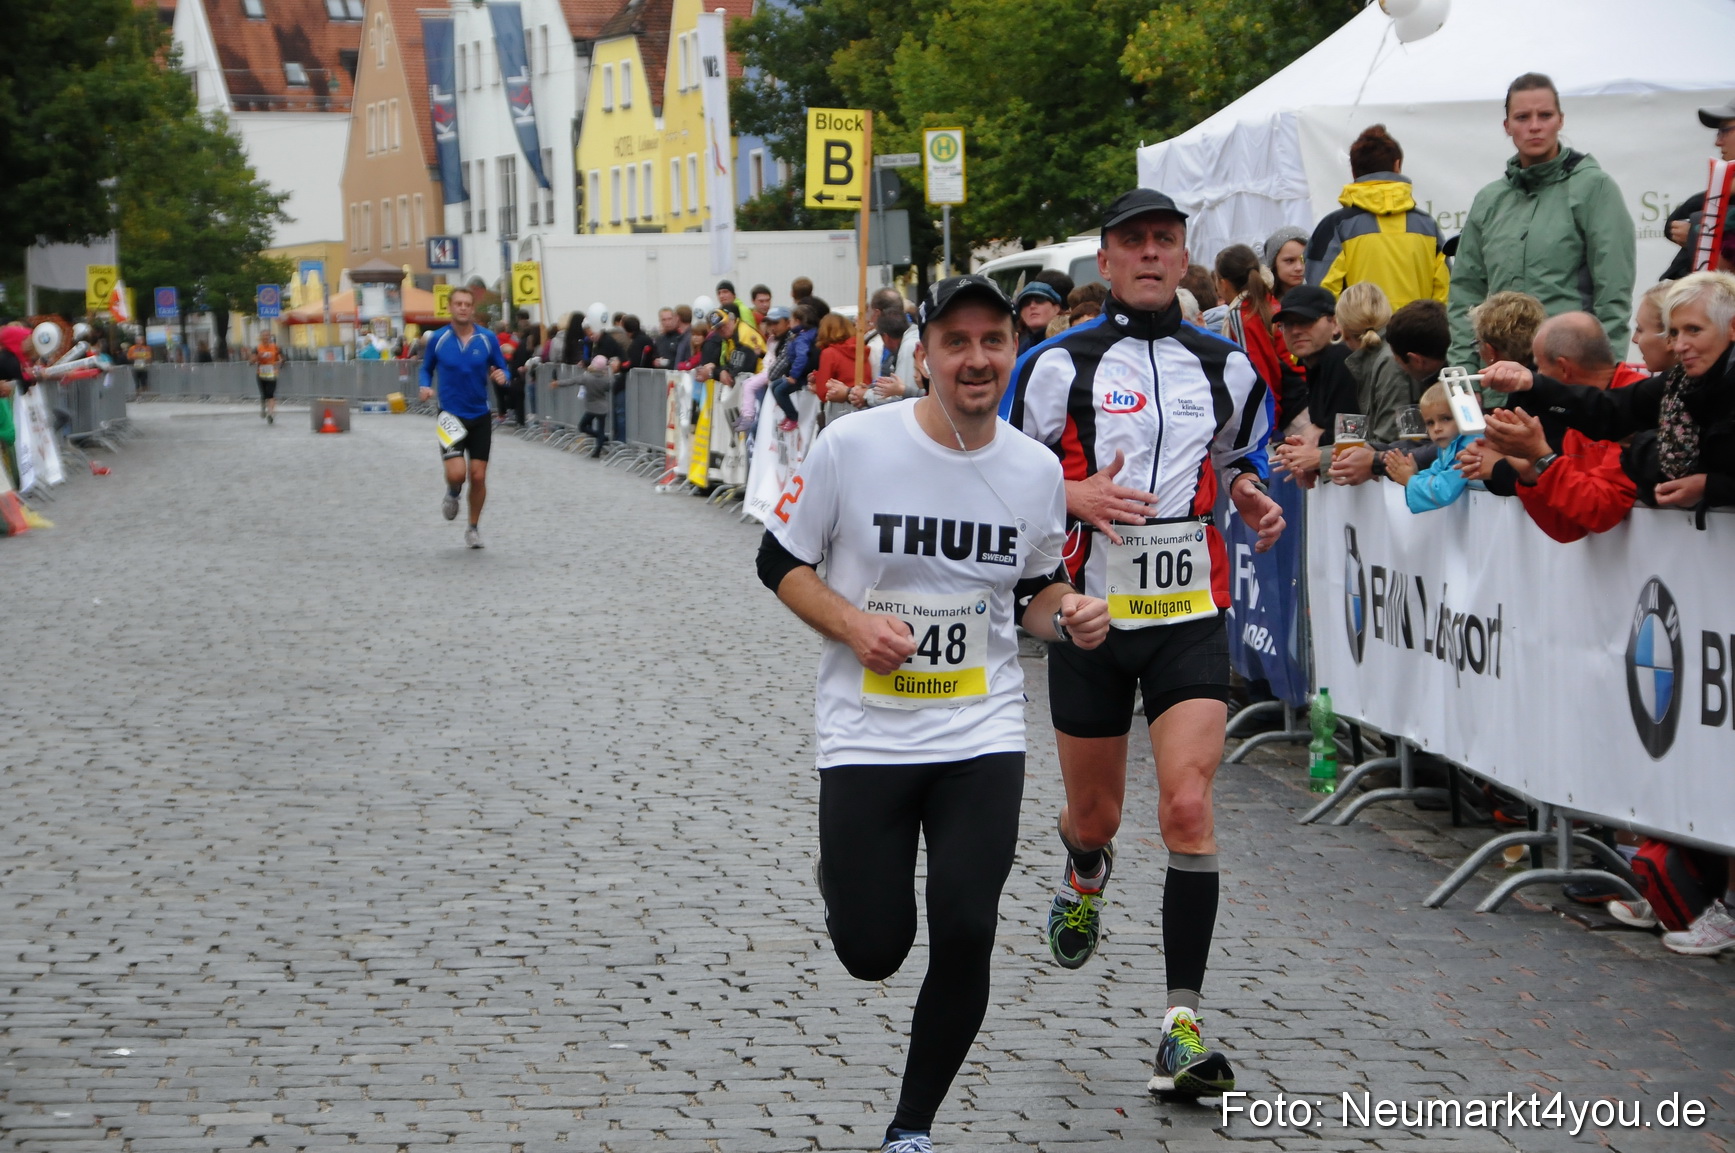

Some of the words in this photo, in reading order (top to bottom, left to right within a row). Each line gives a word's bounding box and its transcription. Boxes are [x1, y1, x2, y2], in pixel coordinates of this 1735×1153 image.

[816, 113, 864, 131] Block
[823, 139, 853, 186] B
[93, 277, 109, 299] C
[520, 274, 534, 295] C
[158, 306, 176, 315] TAXI
[260, 306, 278, 315] TAXI
[1104, 390, 1135, 406] tkn
[1172, 410, 1199, 418] nürnberg
[873, 513, 1018, 566] THULE
[1150, 533, 1193, 546] Neumarkt
[981, 552, 1014, 563] SWEDEN
[1132, 549, 1193, 590] 106
[867, 600, 910, 614] PARTL
[913, 605, 971, 617] Neumarkt
[1129, 599, 1192, 617] Wolfgang
[894, 675, 959, 695] Günther
